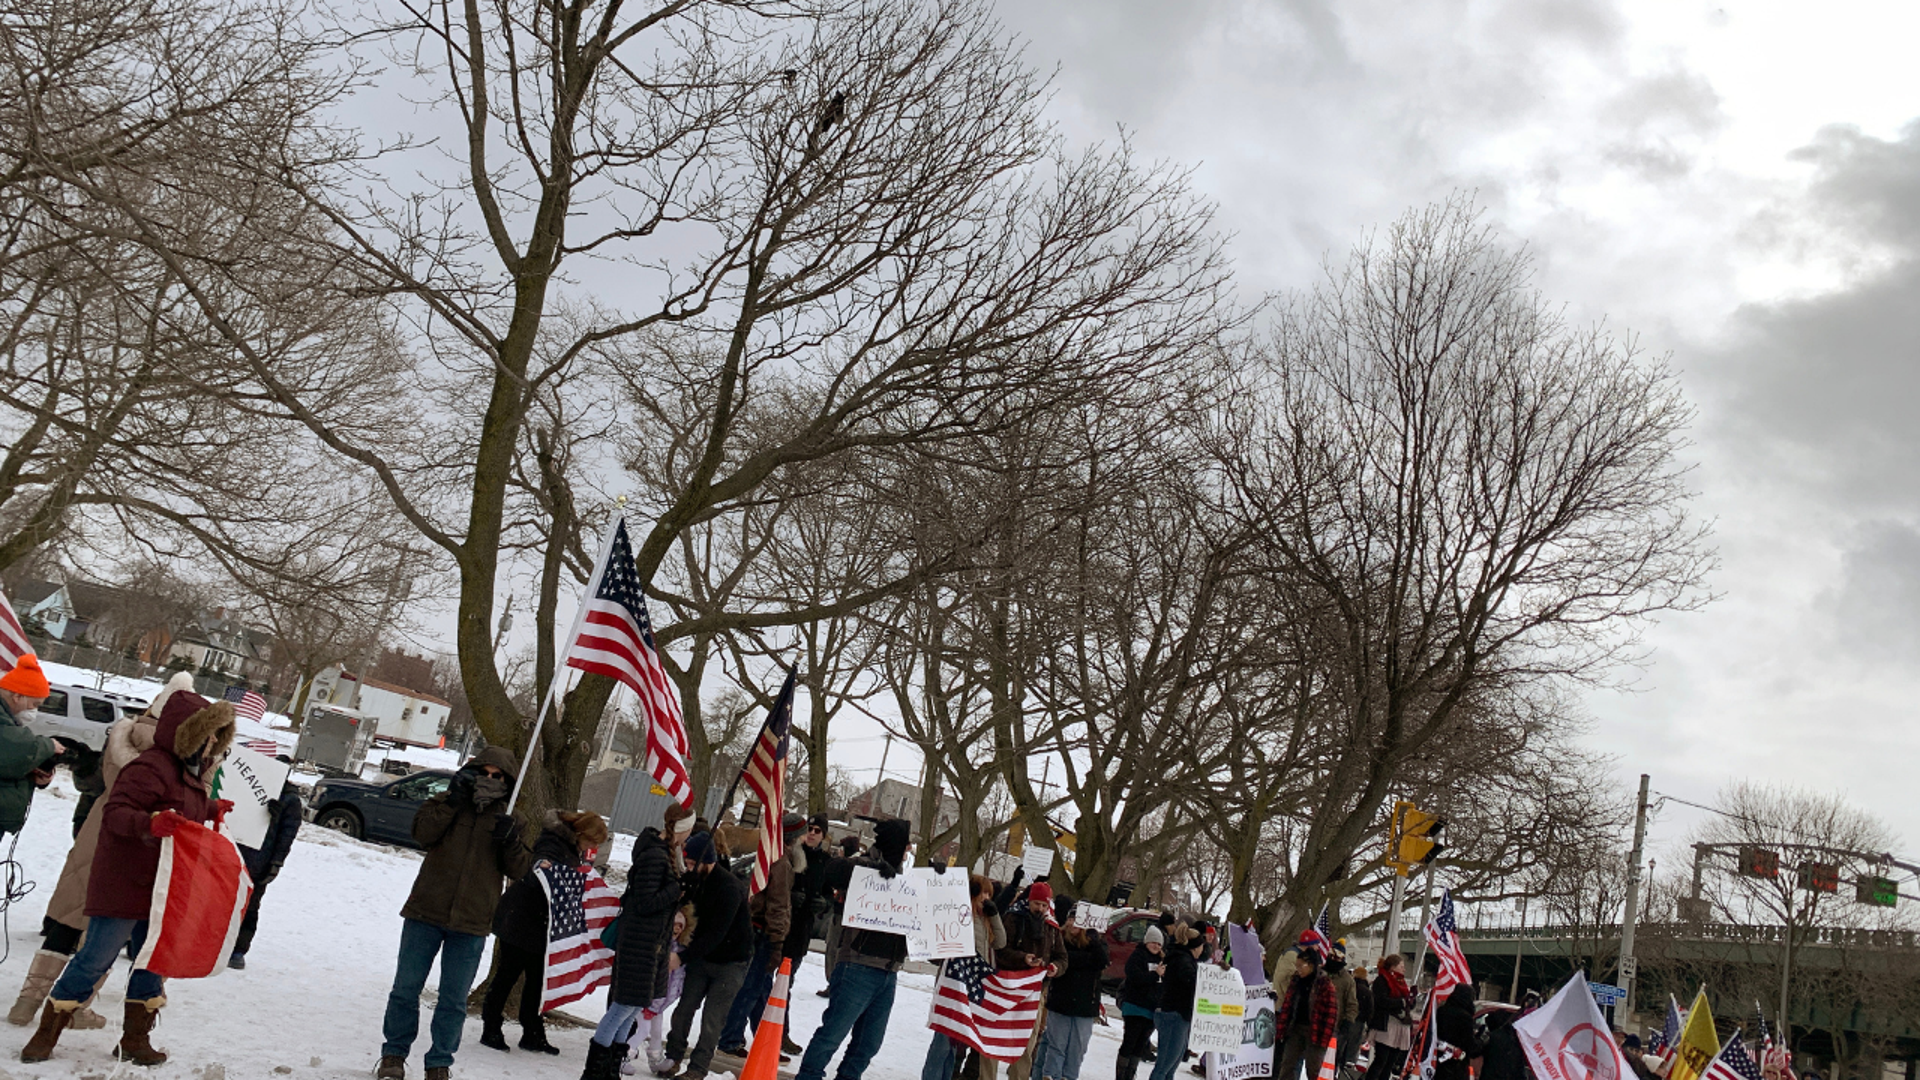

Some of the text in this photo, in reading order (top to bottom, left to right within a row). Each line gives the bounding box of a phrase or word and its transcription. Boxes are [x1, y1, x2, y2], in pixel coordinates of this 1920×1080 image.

[232, 757, 269, 806] HEAVEN
[861, 873, 918, 897] Thank You
[856, 893, 919, 919] Truckers!
[934, 920, 961, 942] NO
[1199, 965, 1237, 981] MANDATE
[1192, 1018, 1242, 1035] AUTONOMY
[1228, 1062, 1270, 1079] PASSPORTS
[1533, 1042, 1561, 1079] MY BODY
